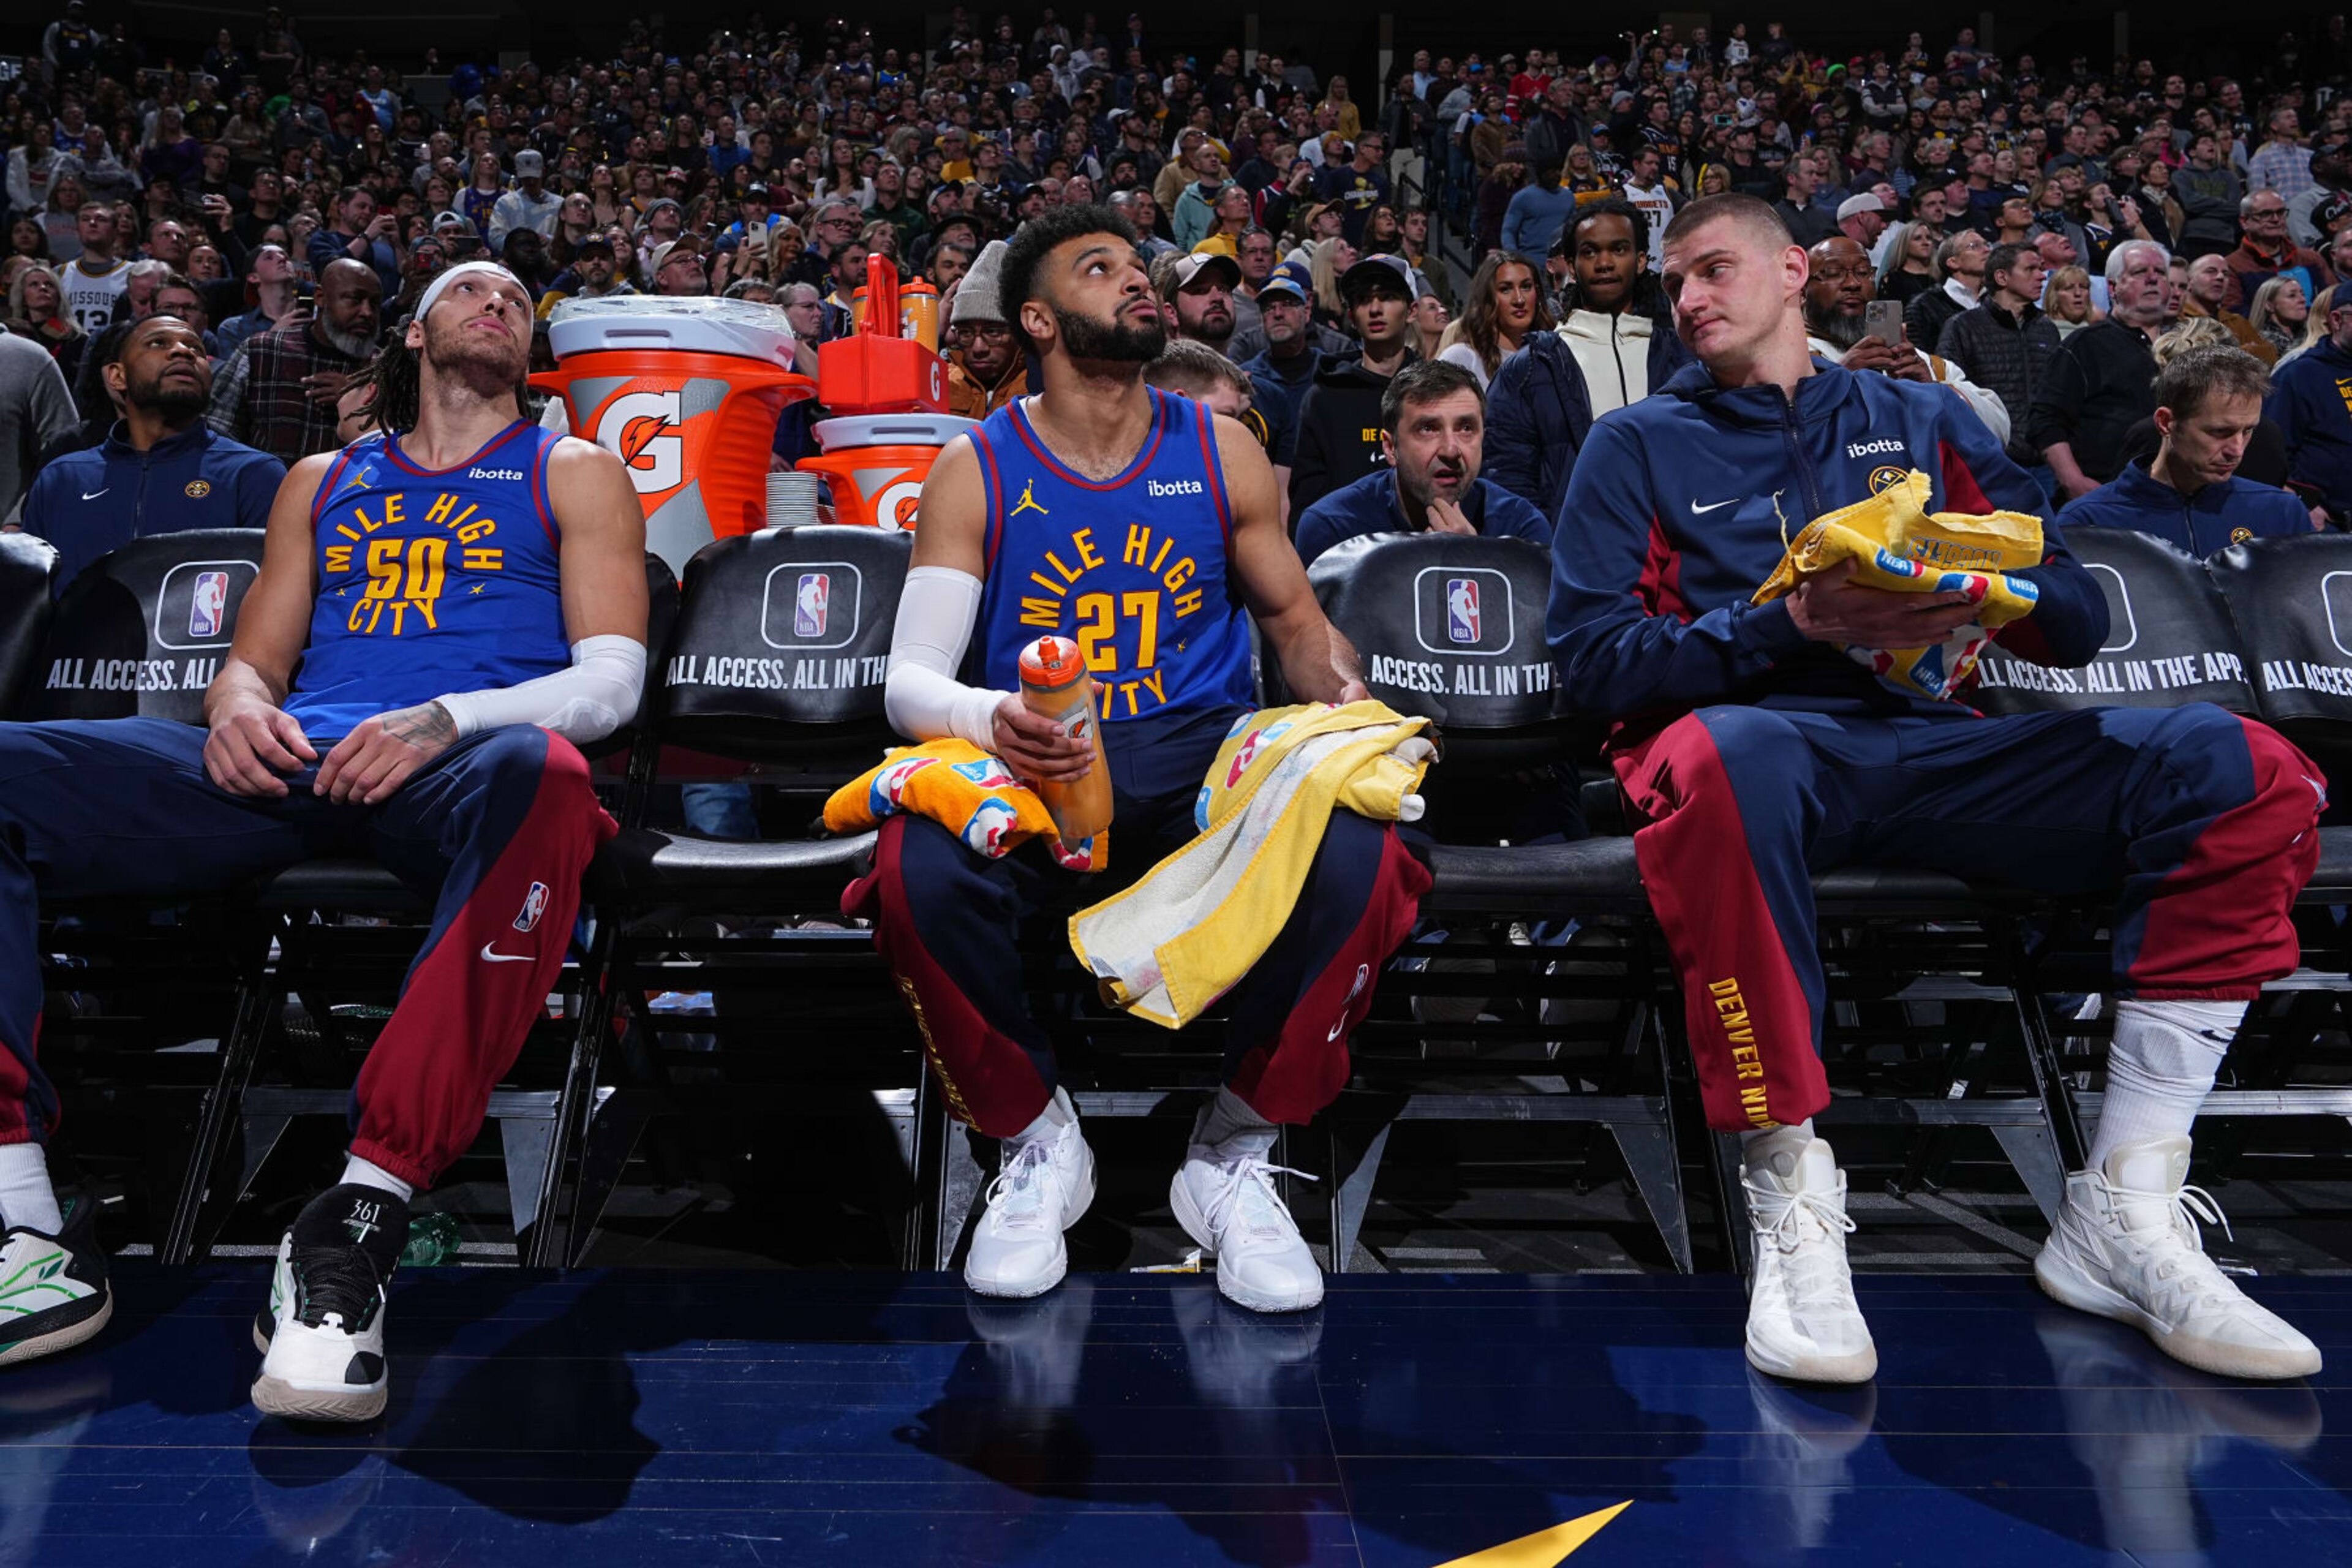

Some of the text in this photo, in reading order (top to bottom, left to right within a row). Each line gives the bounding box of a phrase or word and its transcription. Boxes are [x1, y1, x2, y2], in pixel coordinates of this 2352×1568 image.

[596, 391, 683, 494] G
[1847, 439, 1905, 458] ibotta
[469, 467, 523, 480] ibotta
[1148, 480, 1202, 497] ibotta
[325, 492, 503, 573] MILE HIGH
[364, 537, 450, 600] 50
[1020, 522, 1203, 628] MILE HIGH
[1881, 552, 1909, 571] NBA
[347, 598, 437, 636] CITY
[1076, 590, 1160, 672] 27
[1453, 628, 1469, 638] NBA
[45, 658, 85, 689] ALL
[89, 659, 178, 691] ACCESS.
[665, 655, 889, 690] ALL ACCESS. ALL IN TH
[1371, 654, 1450, 694] ACCESS.
[1455, 665, 1491, 696] ALL
[1495, 665, 1518, 695] IN
[1915, 666, 1942, 690] NBA
[1978, 658, 2007, 688] LL
[2086, 660, 2125, 693] ALL
[2124, 661, 2153, 691] IN
[2152, 655, 2203, 688] THE
[2203, 652, 2248, 684] APP.
[2262, 660, 2305, 692] ALL
[1099, 669, 1167, 720] ITY
[1708, 976, 1764, 1081] DENVER
